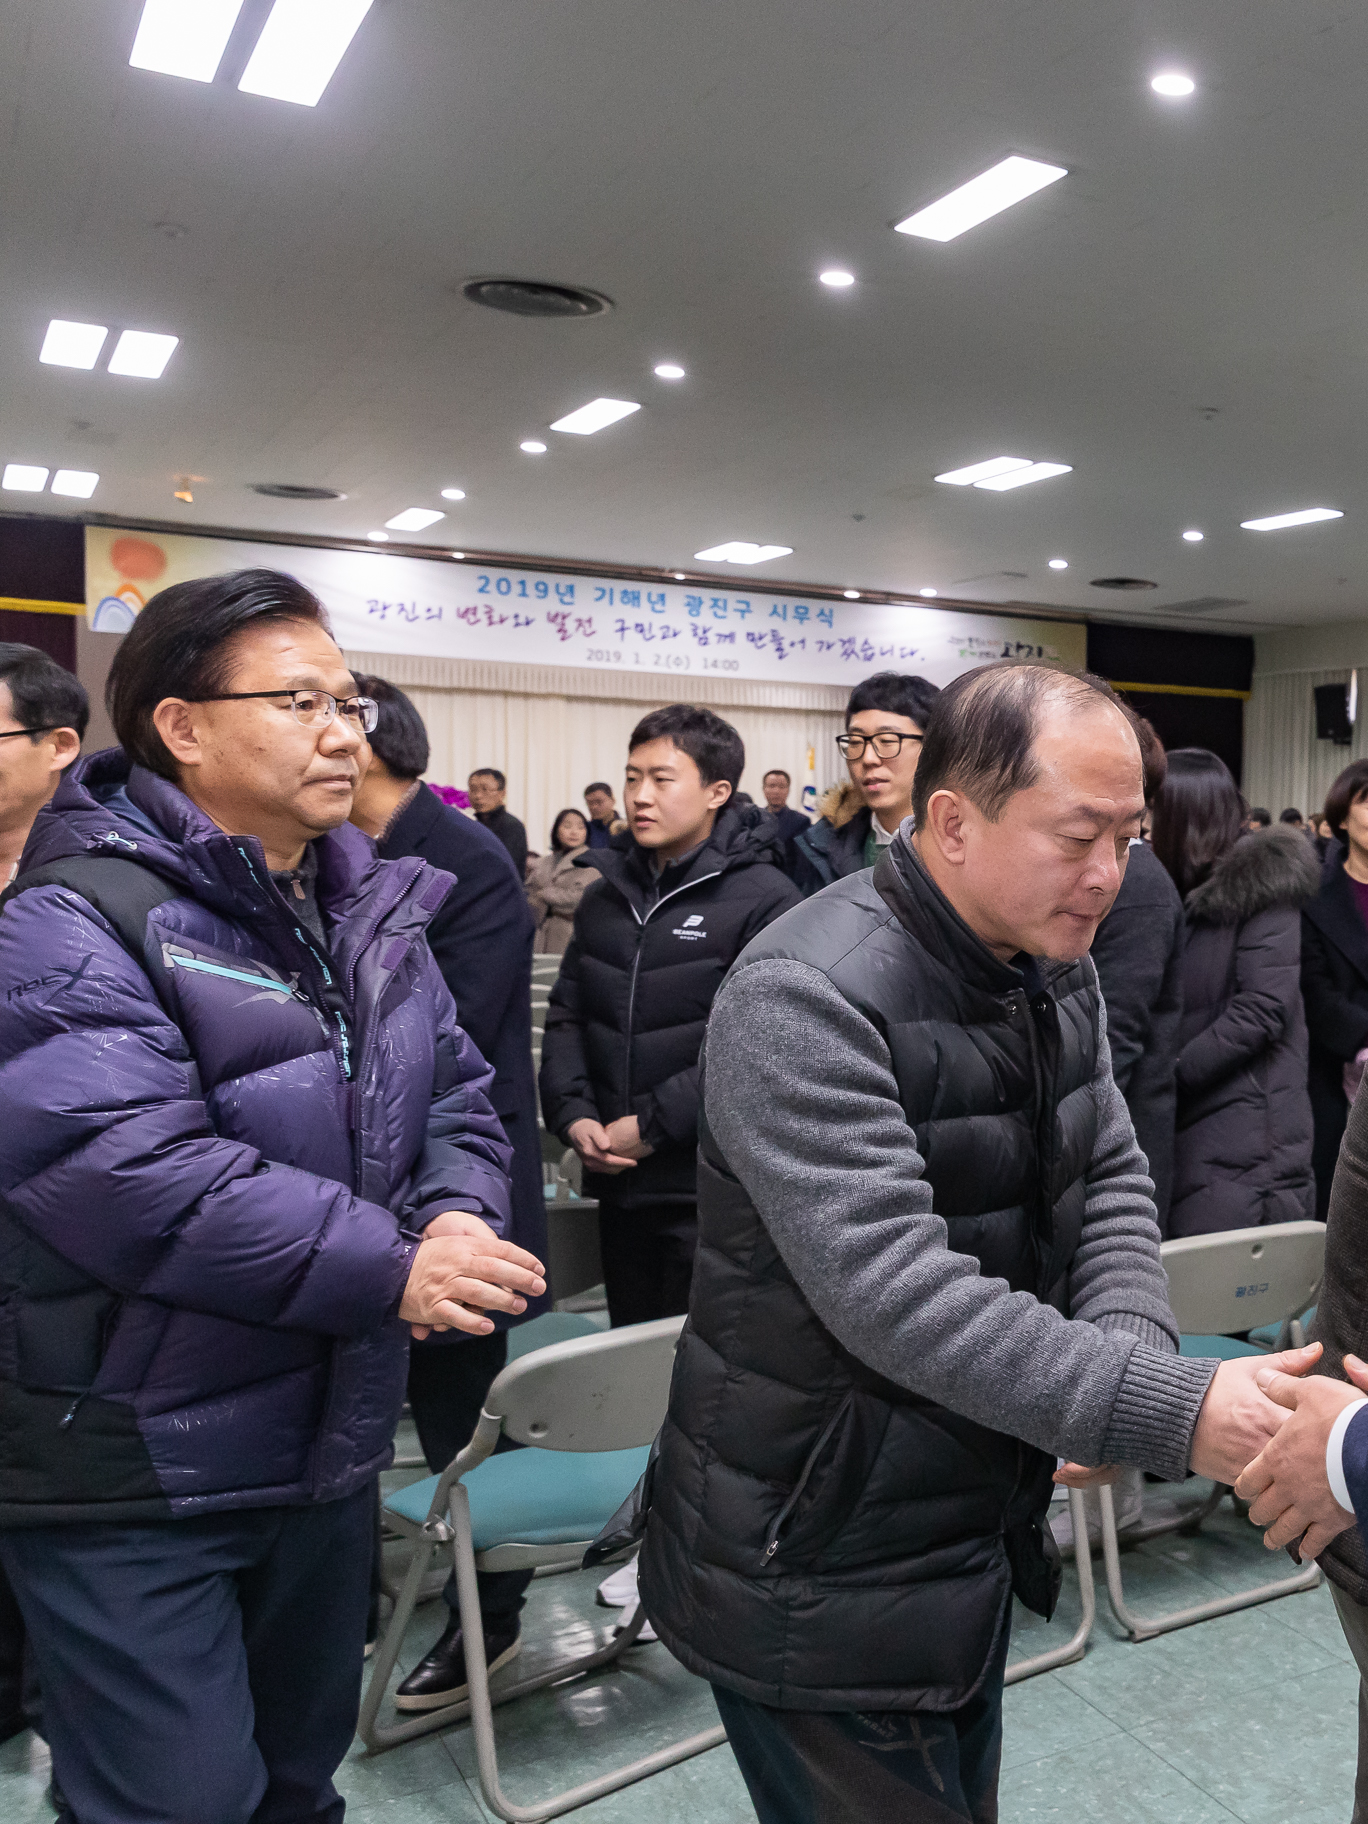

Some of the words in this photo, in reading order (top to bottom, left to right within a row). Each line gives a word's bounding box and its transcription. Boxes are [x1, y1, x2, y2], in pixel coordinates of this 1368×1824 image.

[476, 575, 576, 606] 2019년
[593, 586, 667, 614] 기해년
[684, 594, 753, 620] 광진구
[768, 603, 835, 629] 시무식
[366, 599, 443, 623] 광진의
[456, 604, 535, 628] 변화와
[546, 610, 597, 642] 발전
[614, 618, 681, 642] 구민과
[690, 622, 736, 646] 함께
[746, 628, 806, 660] 만들어
[815, 635, 926, 662] 가겠습니다.
[586, 648, 625, 664] 2019.
[702, 657, 740, 672] 14:00
